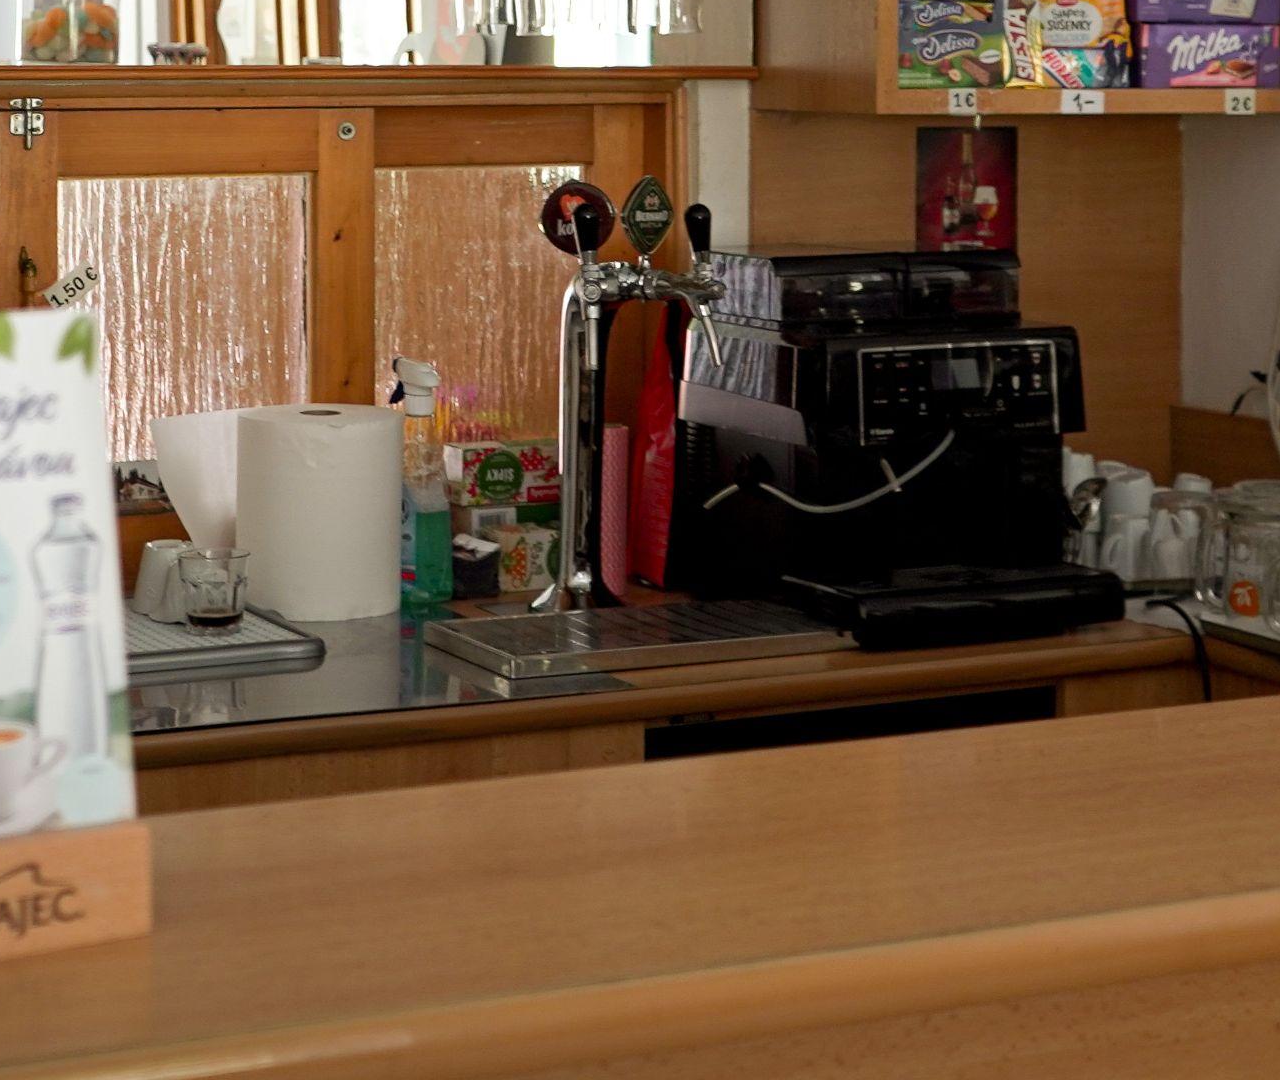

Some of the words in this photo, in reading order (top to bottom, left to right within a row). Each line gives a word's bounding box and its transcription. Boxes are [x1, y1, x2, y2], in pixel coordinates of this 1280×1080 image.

[922, 33, 977, 61] Delissa
[1167, 30, 1244, 73] Milka
[953, 93, 962, 108] 1
[964, 93, 976, 108] €
[1230, 97, 1241, 111] 2
[1242, 96, 1252, 111] €
[49, 276, 85, 308] 1,50
[84, 266, 99, 282] €
